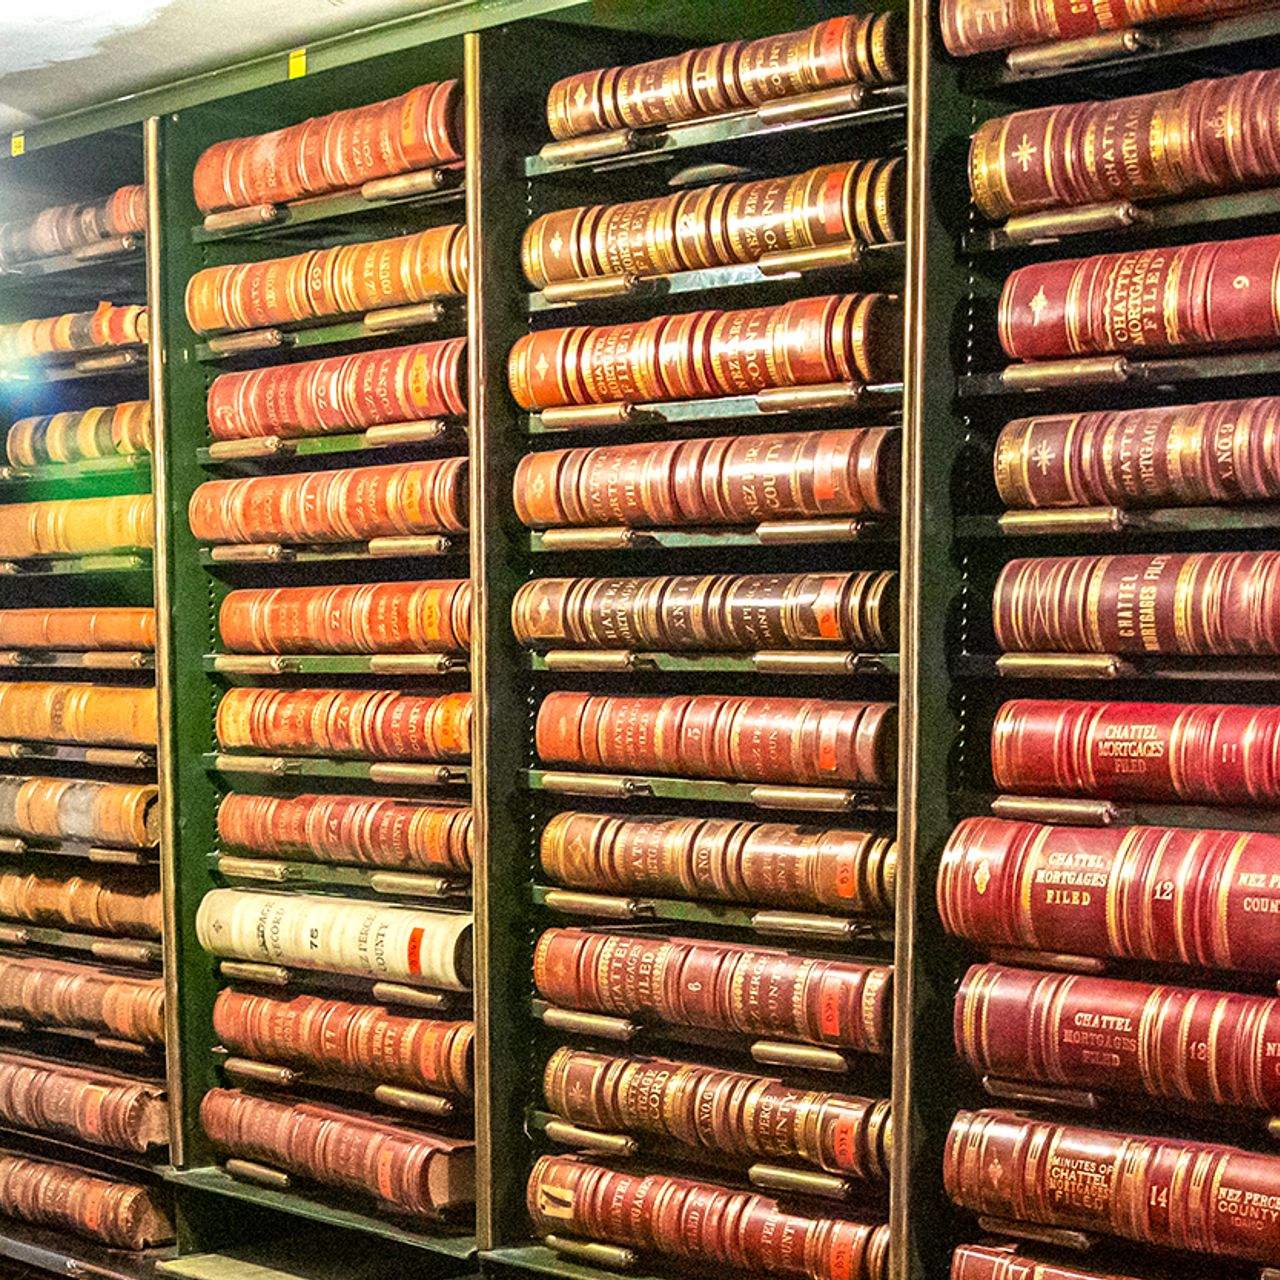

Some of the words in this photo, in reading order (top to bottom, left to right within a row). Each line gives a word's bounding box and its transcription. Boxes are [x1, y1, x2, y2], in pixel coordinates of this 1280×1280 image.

[312, 267, 321, 291] 69
[1233, 275, 1250, 289] 9
[1143, 256, 1165, 330] FILED
[317, 386, 326, 408] 70
[305, 495, 315, 511] 71
[1119, 574, 1139, 639] CHATTEL
[331, 609, 341, 629] 72
[337, 705, 349, 730] 73
[1105, 724, 1158, 740] CHATTEL
[1098, 740, 1164, 759] MORTGAGES
[1114, 757, 1147, 774] FILED
[328, 818, 339, 842] 74
[1048, 850, 1106, 868] CHATTEL
[1036, 870, 1108, 888] MORTGAGES
[1238, 872, 1269, 888] NEZ
[1046, 890, 1092, 906] FILED
[1154, 881, 1174, 900] 12
[687, 981, 700, 992] 6
[1074, 1012, 1133, 1032] CHATTEL
[1063, 1030, 1137, 1052] MORTGAGES
[1081, 1048, 1121, 1067] FILED
[1052, 1154, 1098, 1174] MINUTES
[1100, 1163, 1114, 1176] OF
[1051, 1166, 1109, 1189] CHATTEL
[1150, 1186, 1168, 1208] 14
[1218, 1186, 1241, 1202] NEZ
[1218, 1200, 1280, 1222] COUNTY
